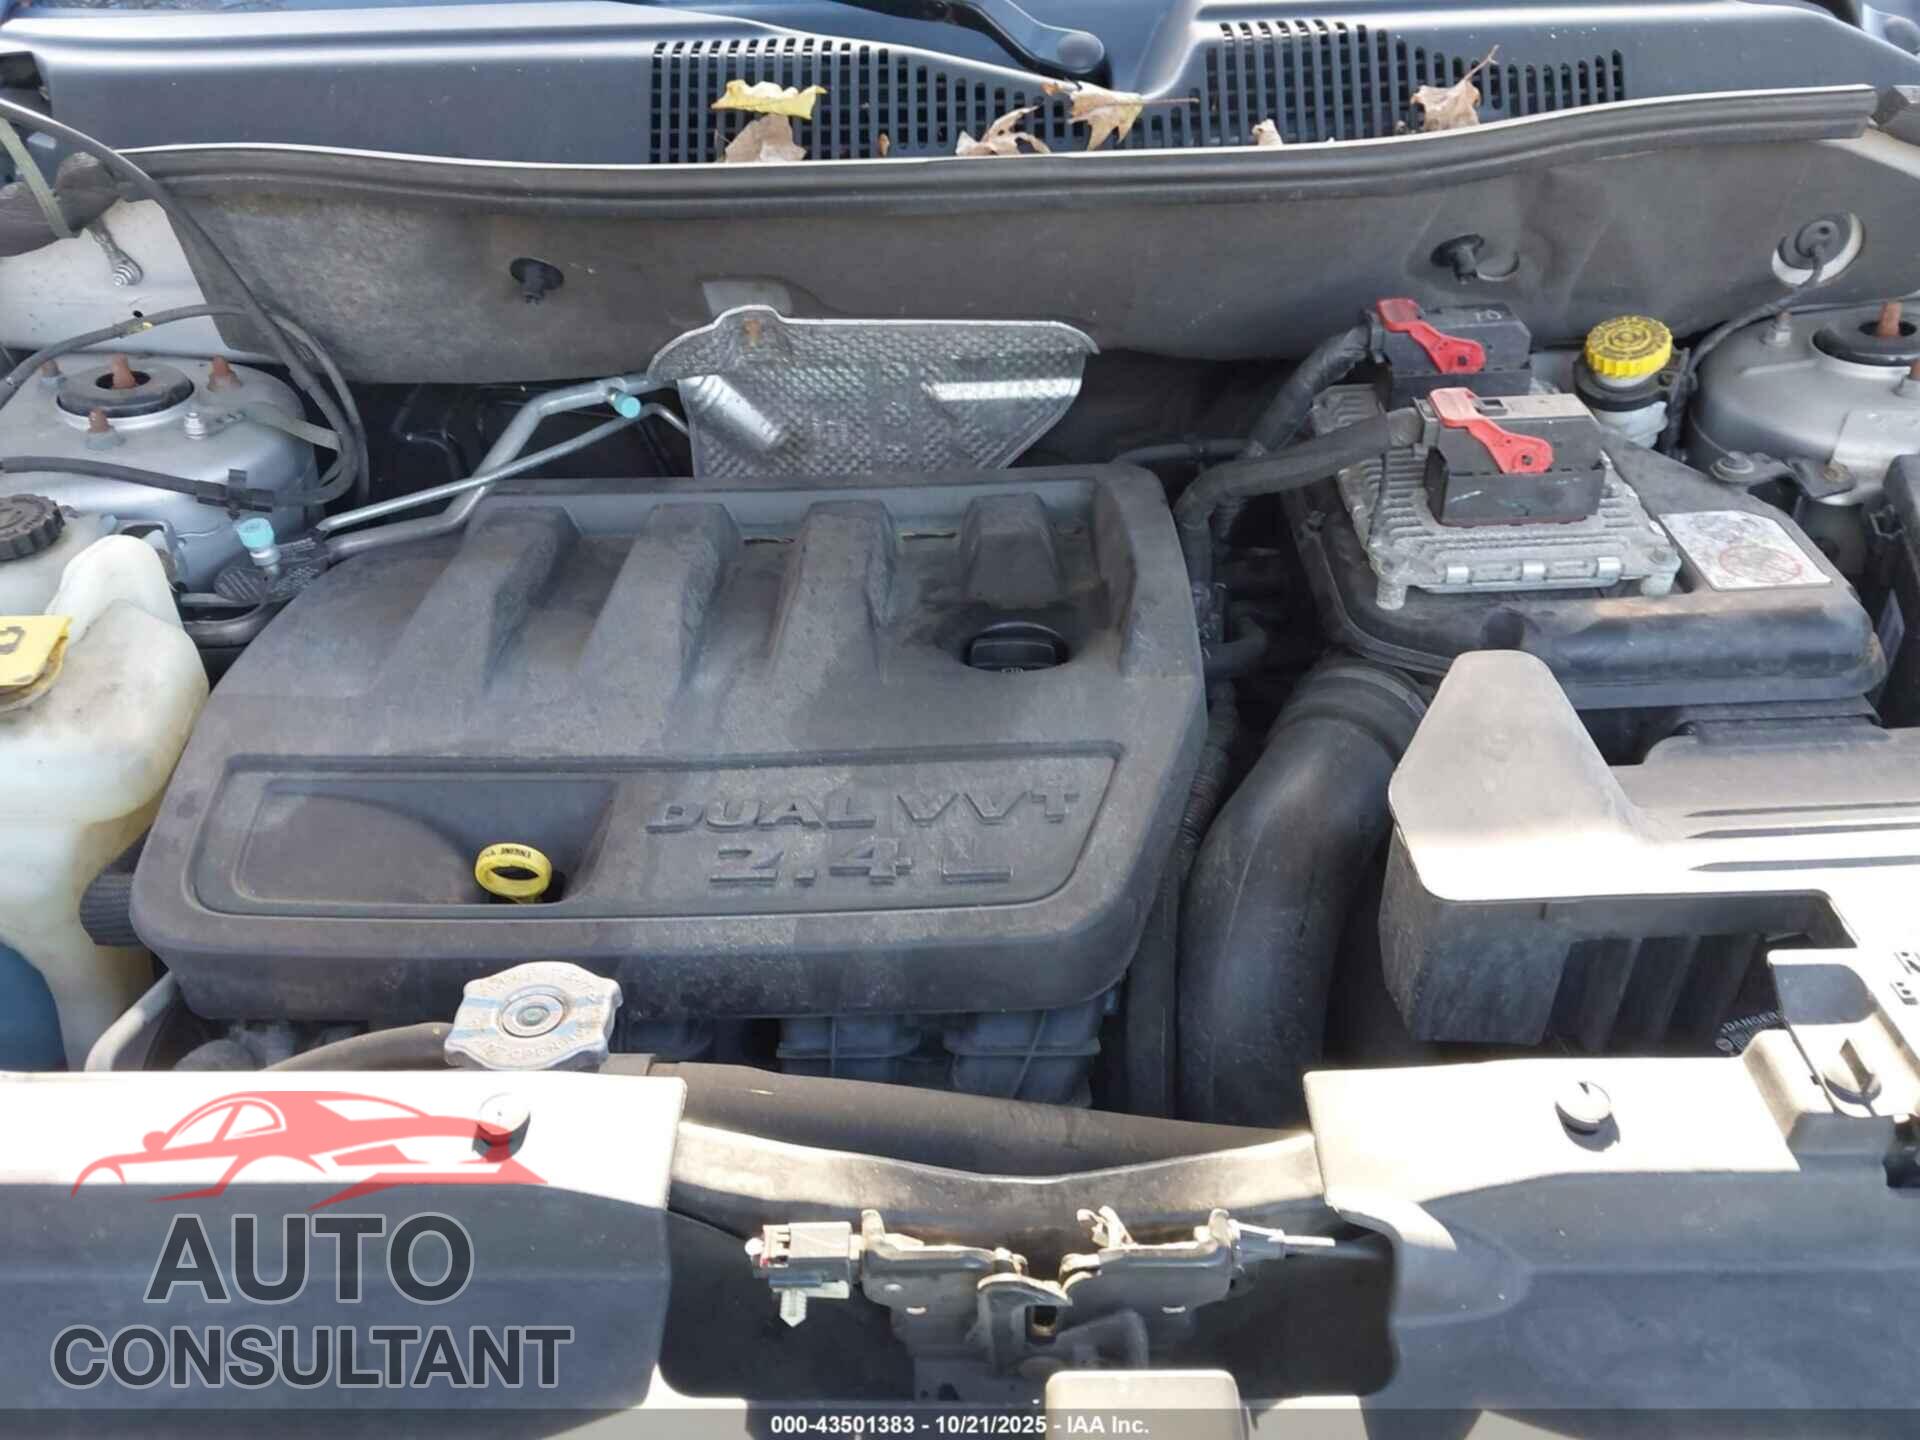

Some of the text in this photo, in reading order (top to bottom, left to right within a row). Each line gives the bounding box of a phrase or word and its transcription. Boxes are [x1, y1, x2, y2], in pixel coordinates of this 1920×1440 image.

[645, 788, 1081, 834] DUAL VVT
[708, 838, 1014, 886] 2.4L
